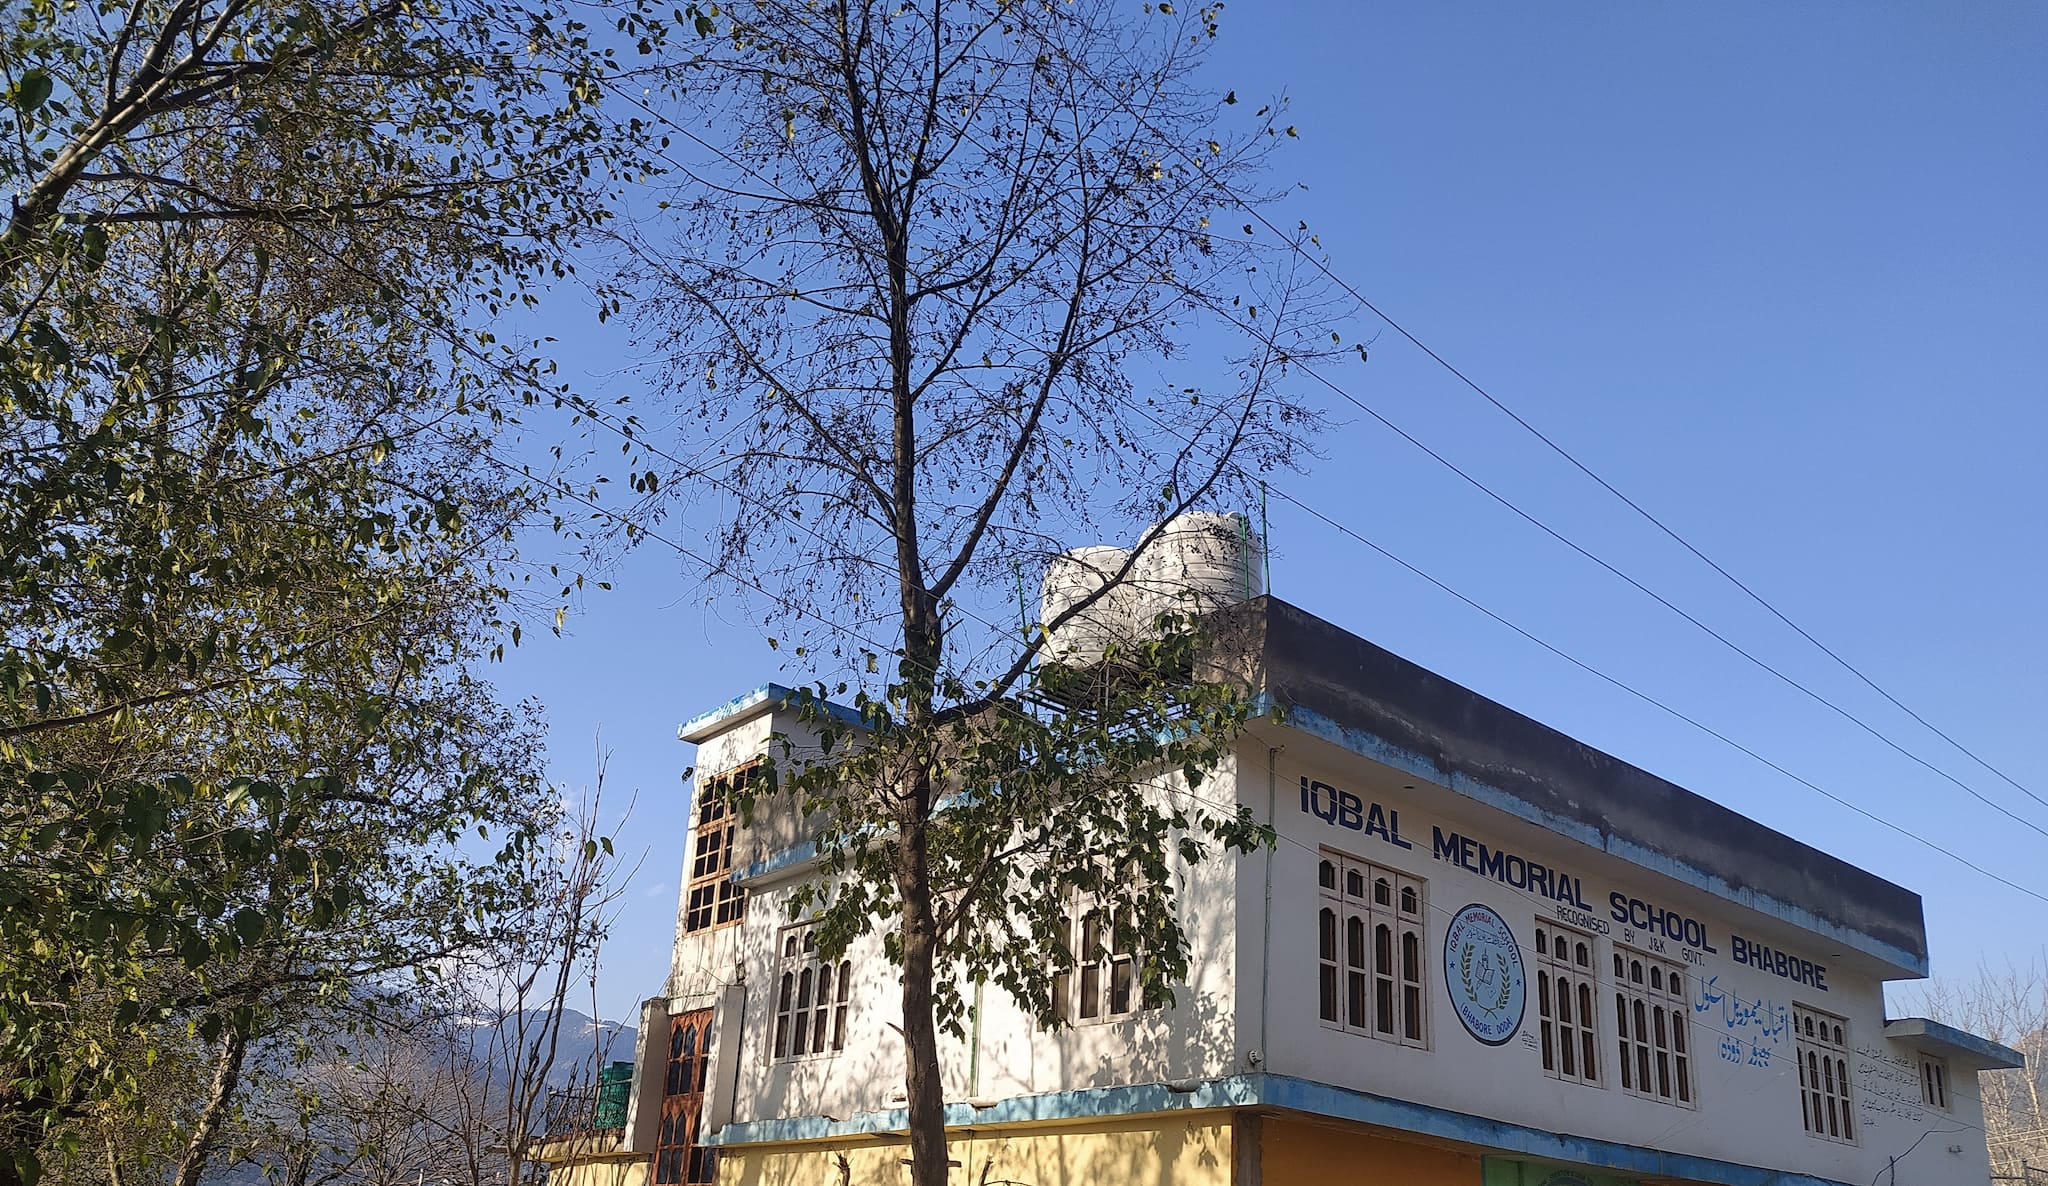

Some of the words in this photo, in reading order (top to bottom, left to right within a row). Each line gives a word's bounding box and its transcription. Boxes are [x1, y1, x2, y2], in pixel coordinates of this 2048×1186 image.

[1300, 776, 1412, 850] IQBAL
[1432, 825, 1592, 912] MEMORIAL
[1609, 892, 1717, 955] SCHOOL
[1731, 934, 1828, 992] BHABORE
[1450, 921, 1466, 953] IQBAL
[1465, 912, 1496, 929] MEMORIAL
[1497, 925, 1519, 969] SCHOOL
[1556, 905, 1610, 935] RECOGNISED
[1624, 928, 1635, 945] BY
[1648, 938, 1667, 954] J&K
[1681, 947, 1706, 967] GOVT.
[1460, 1001, 1493, 1036] (BHABORE
[1694, 975, 1726, 1022] اسکول
[1762, 999, 1790, 1043] اقبال
